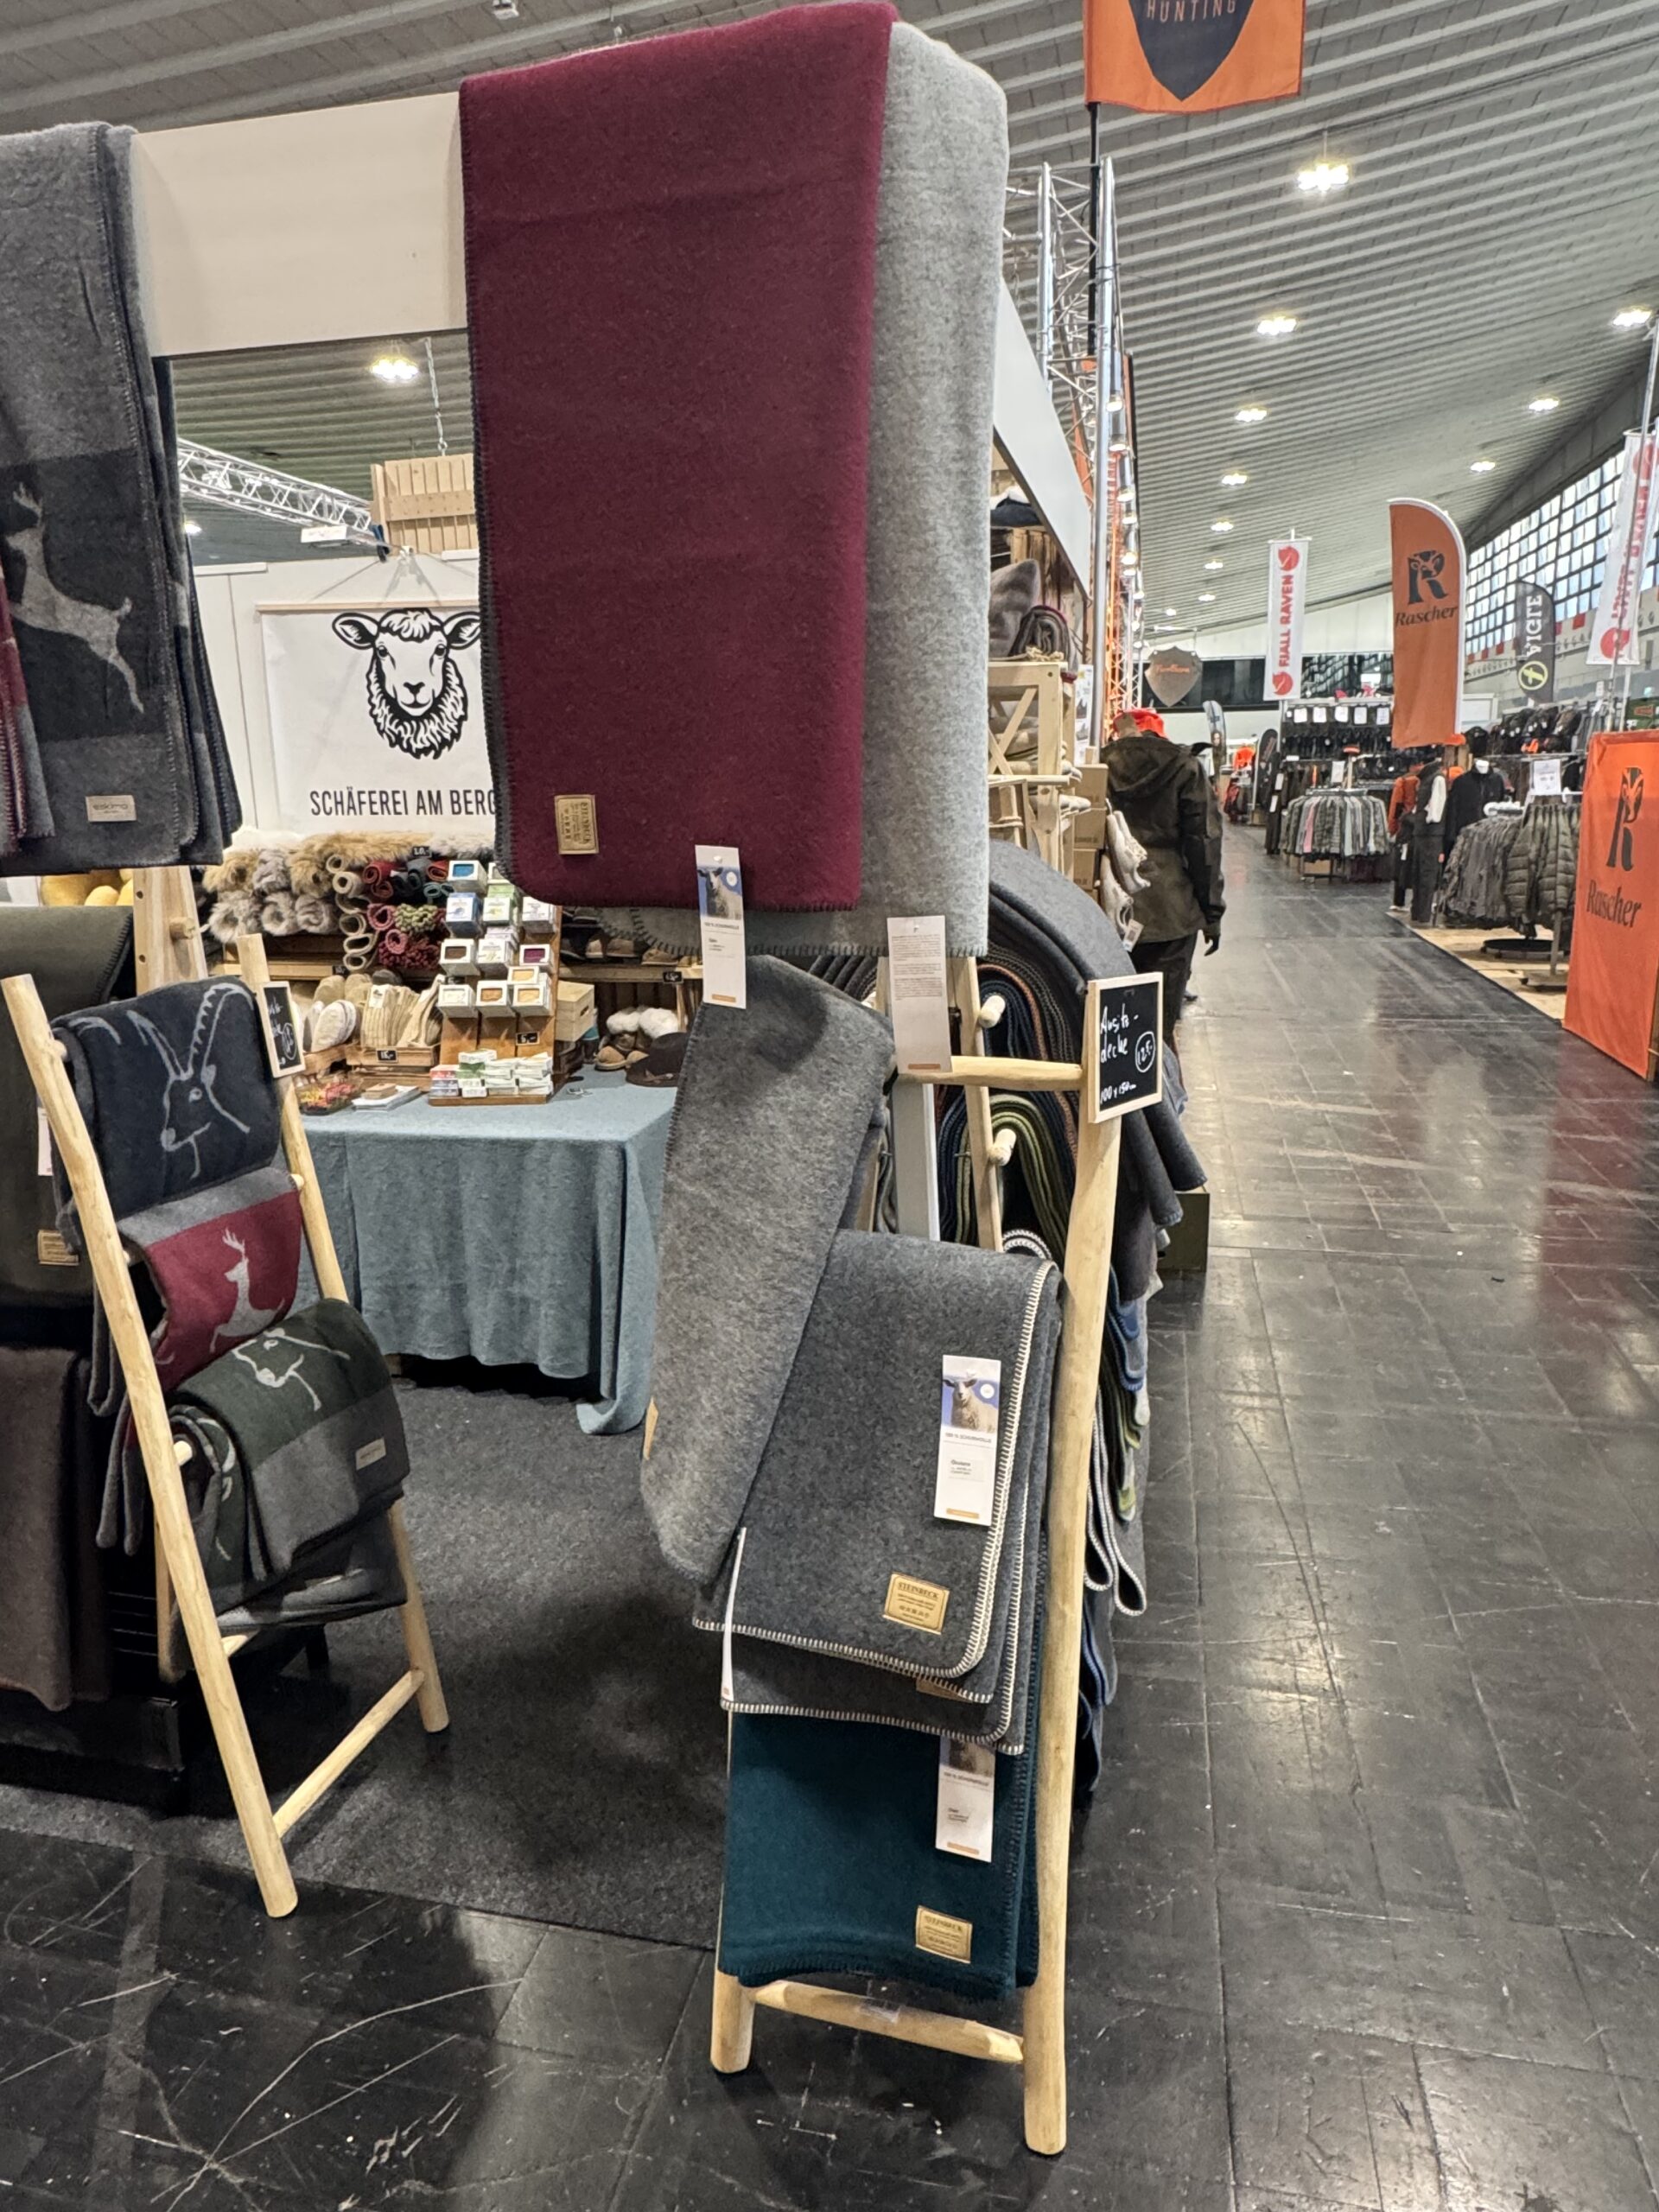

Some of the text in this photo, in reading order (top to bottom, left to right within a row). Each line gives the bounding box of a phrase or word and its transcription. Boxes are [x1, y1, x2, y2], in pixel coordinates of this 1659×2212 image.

[1147, 0, 1236, 22] HUNTING
[1395, 605, 1459, 627] Rascher
[309, 786, 497, 817] SCHÄFEREI AM BERG
[1586, 879, 1642, 929] Rascher
